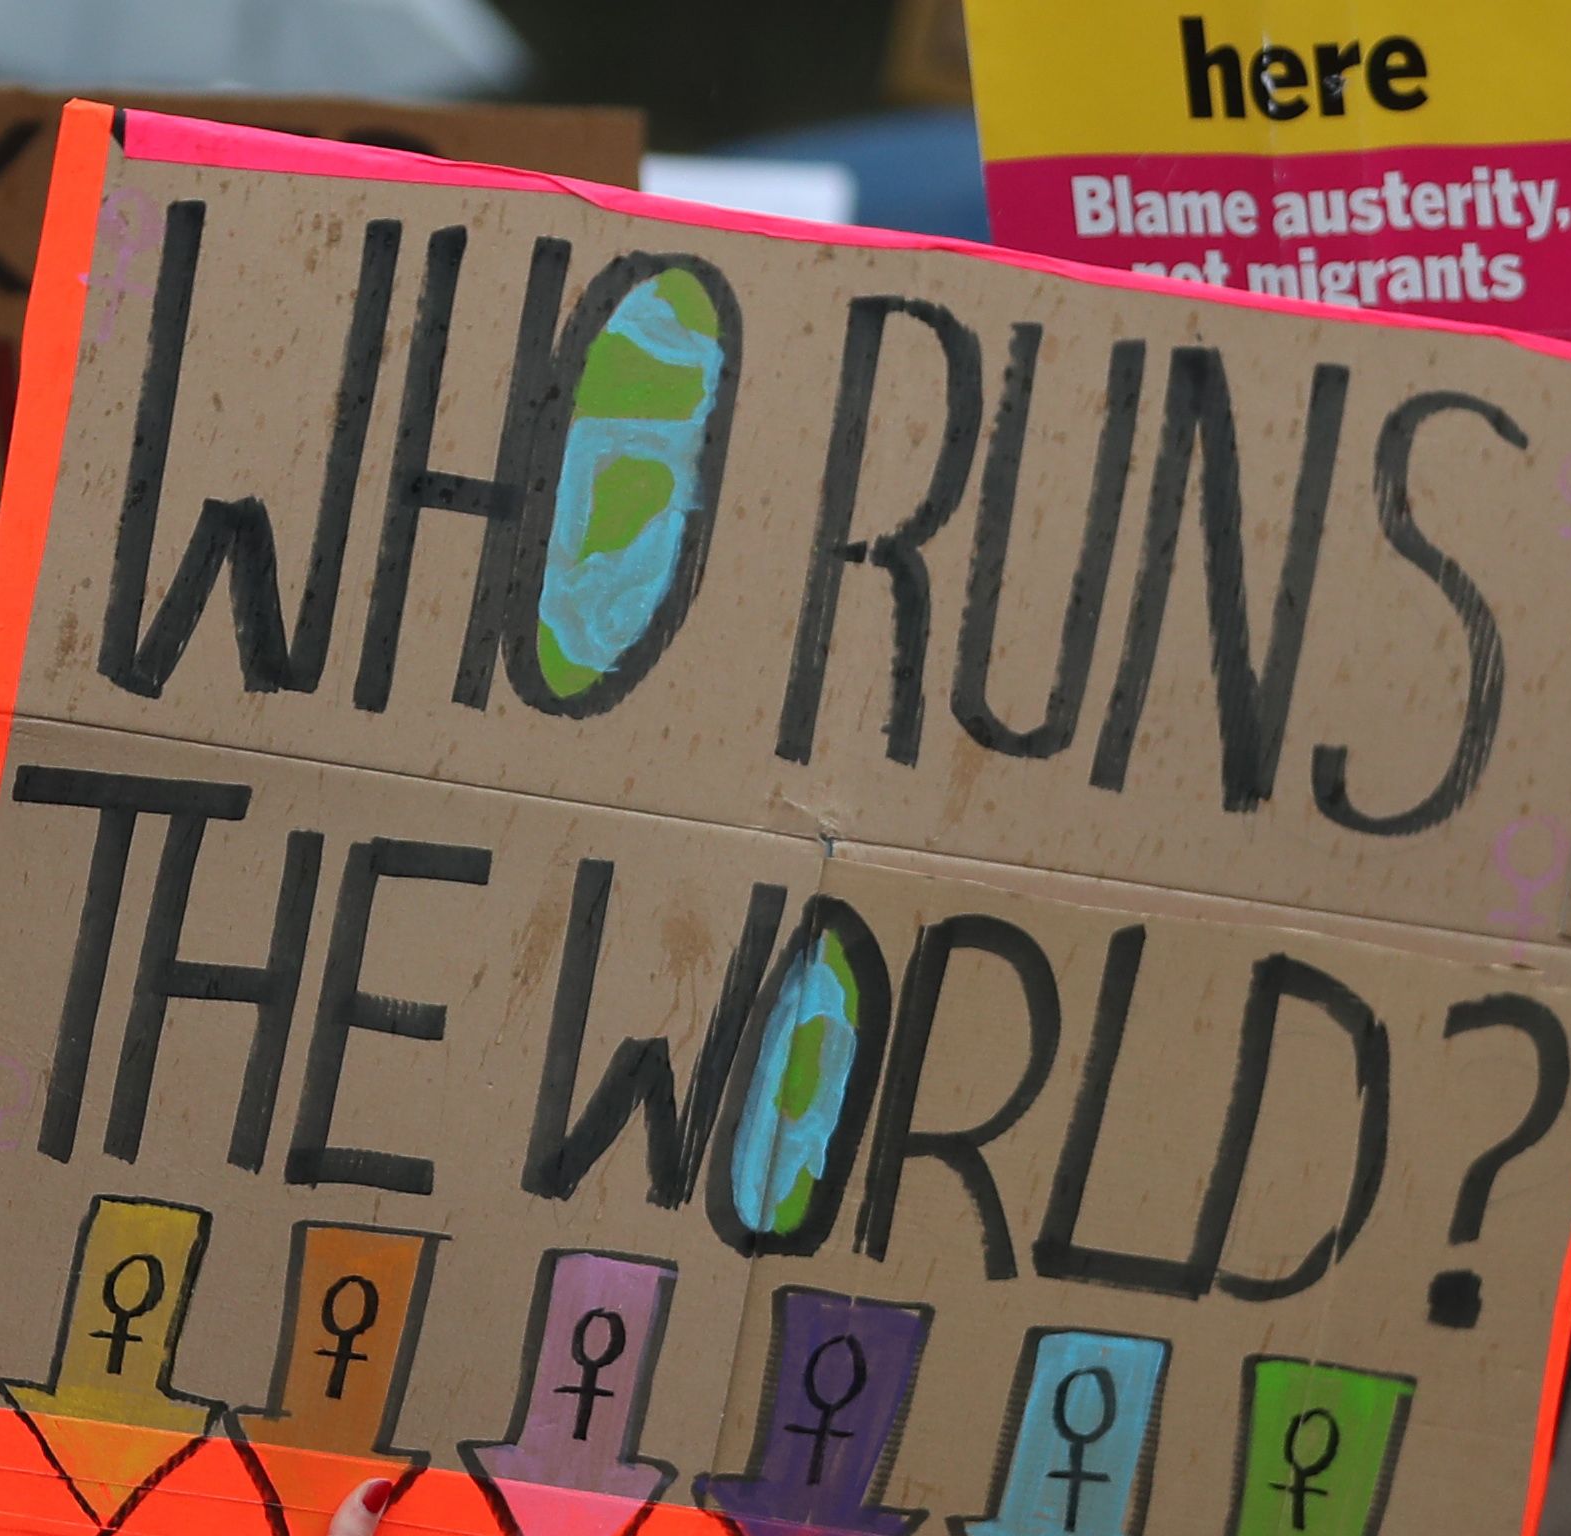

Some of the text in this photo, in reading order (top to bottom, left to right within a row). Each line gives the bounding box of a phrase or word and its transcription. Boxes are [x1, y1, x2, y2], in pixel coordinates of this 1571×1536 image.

[1180, 15, 1430, 121] here
[1070, 174, 1259, 237] Blame
[1247, 241, 1525, 308] migrants
[98, 198, 1530, 836] WHO RUNS
[12, 764, 493, 1196] THE
[520, 857, 1571, 1328] WORLD?
